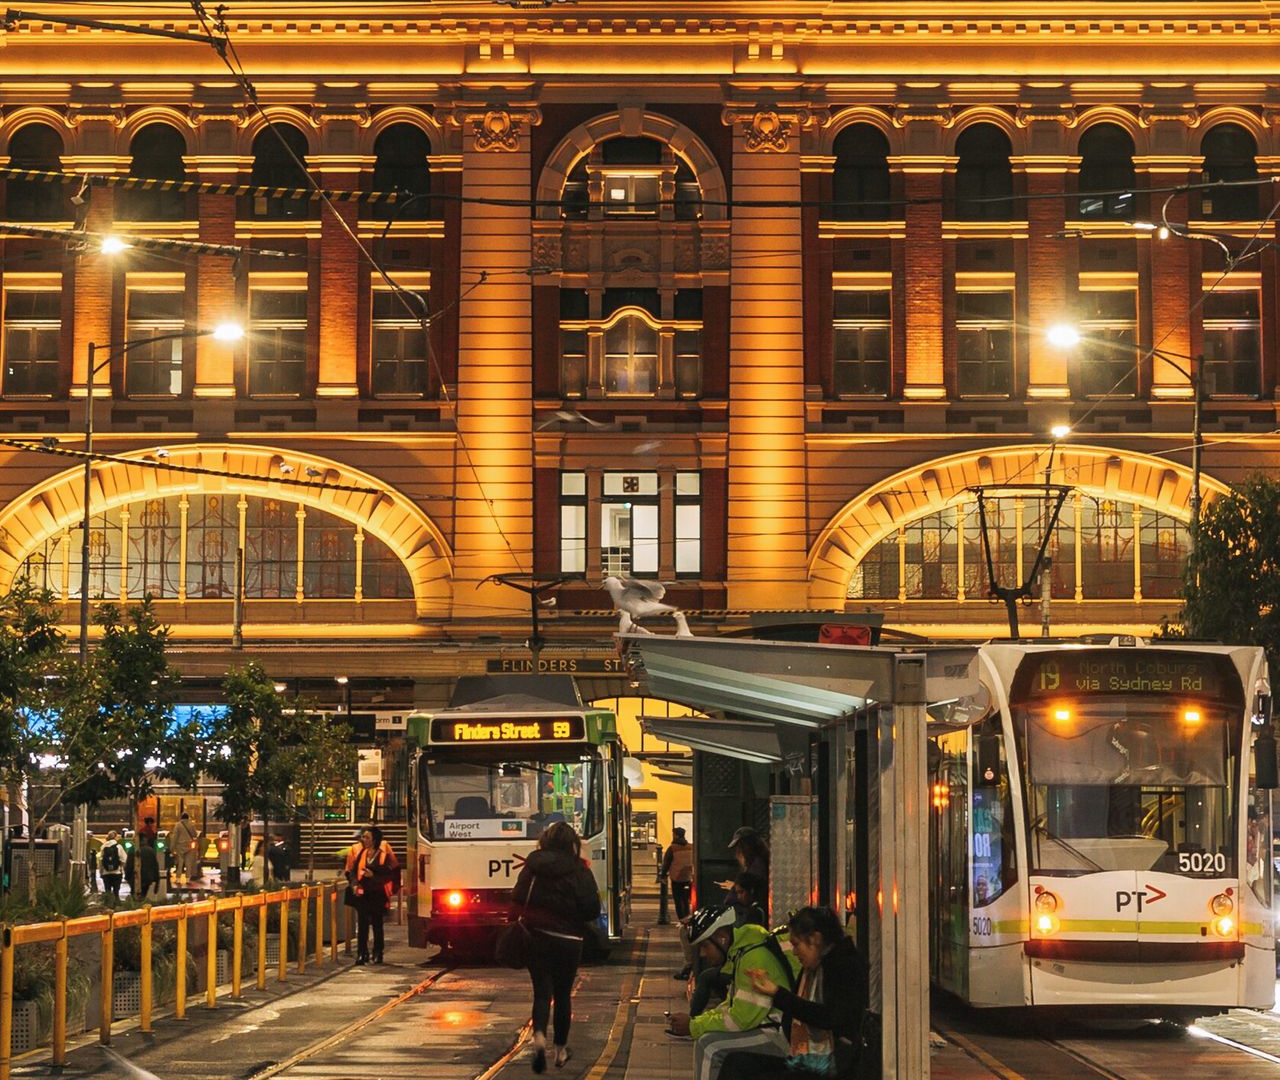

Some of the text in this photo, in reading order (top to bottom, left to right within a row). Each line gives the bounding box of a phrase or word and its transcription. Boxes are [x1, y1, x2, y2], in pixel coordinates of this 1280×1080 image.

[502, 659, 577, 671] FLINDERS
[1079, 662, 1128, 675] North
[1076, 676, 1203, 691] via Sydney Rd
[454, 721, 570, 740] Flinders Street 59
[449, 822, 480, 830] Airport
[1178, 852, 1226, 873] 5020
[972, 917, 992, 936] 5020
